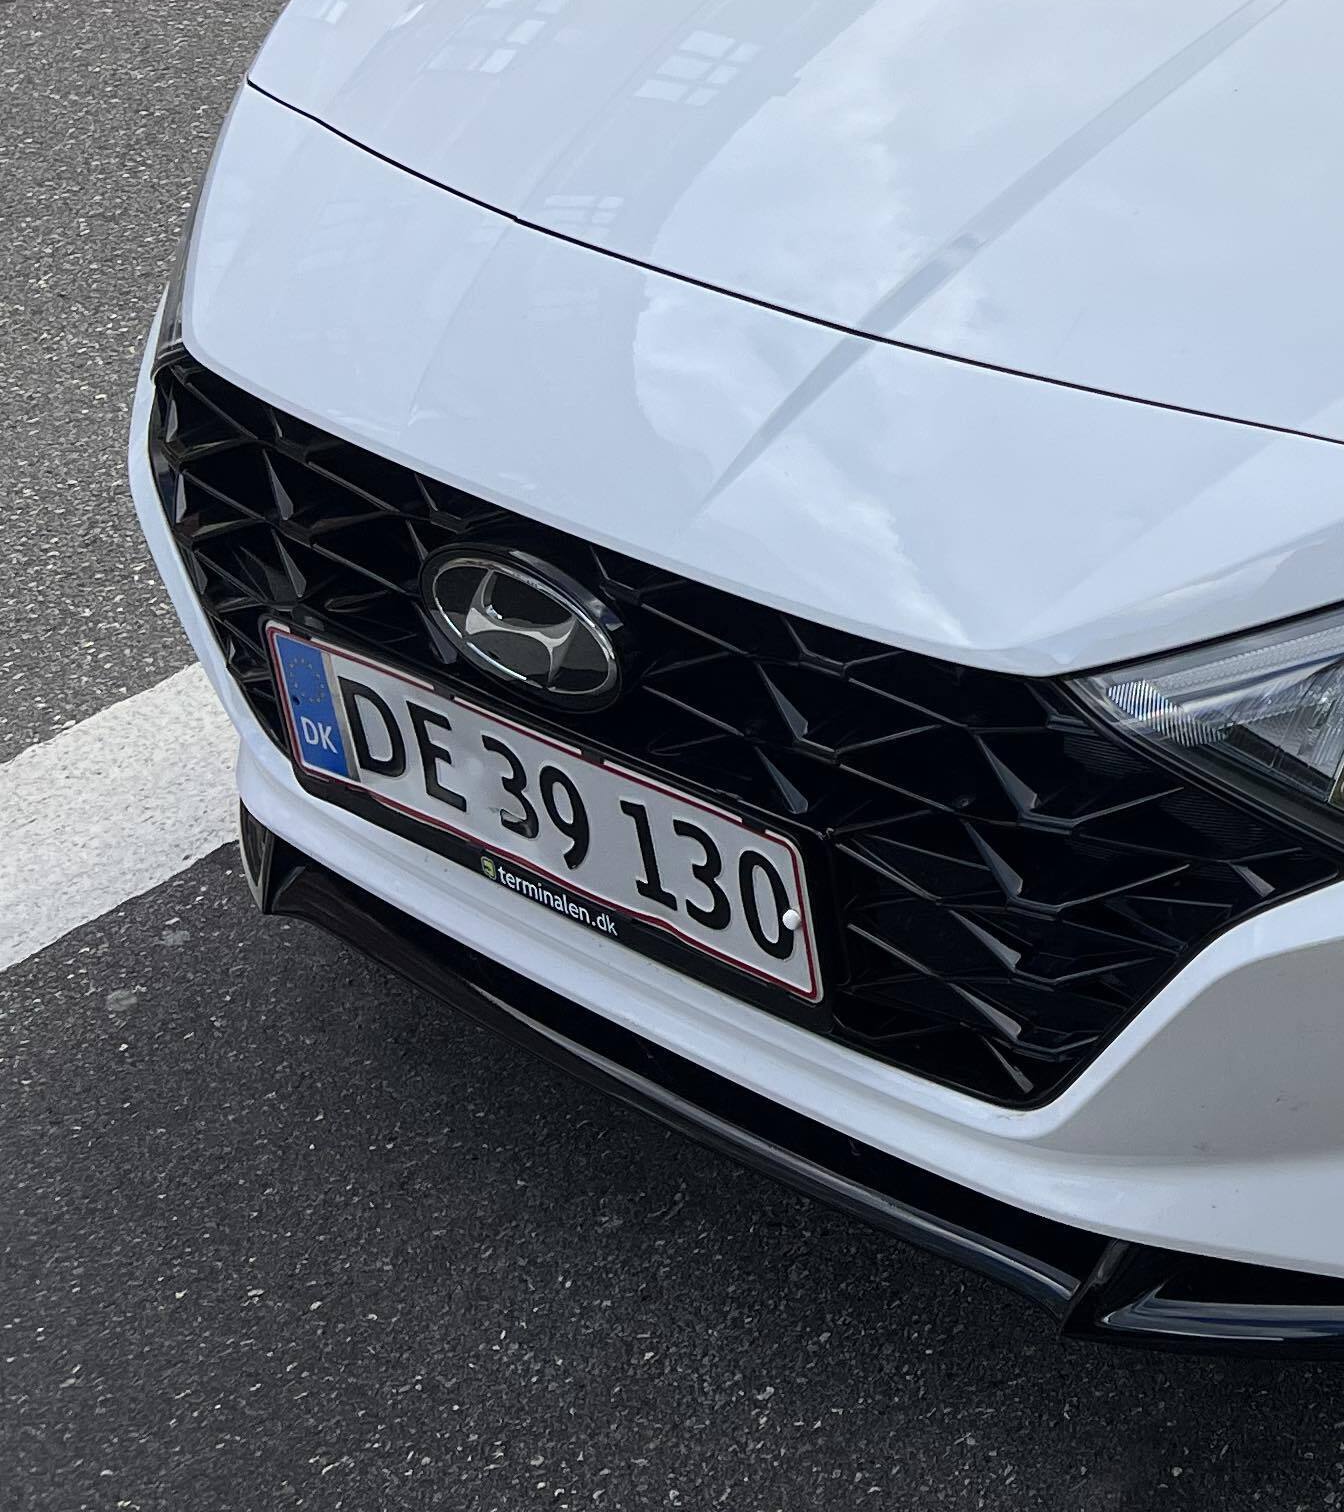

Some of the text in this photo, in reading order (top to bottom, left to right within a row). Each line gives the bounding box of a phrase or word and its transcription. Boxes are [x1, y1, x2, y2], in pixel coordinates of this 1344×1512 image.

[300, 716, 338, 755] DK
[337, 675, 795, 961] DE 39 130
[498, 866, 618, 936] terminalen.dk
